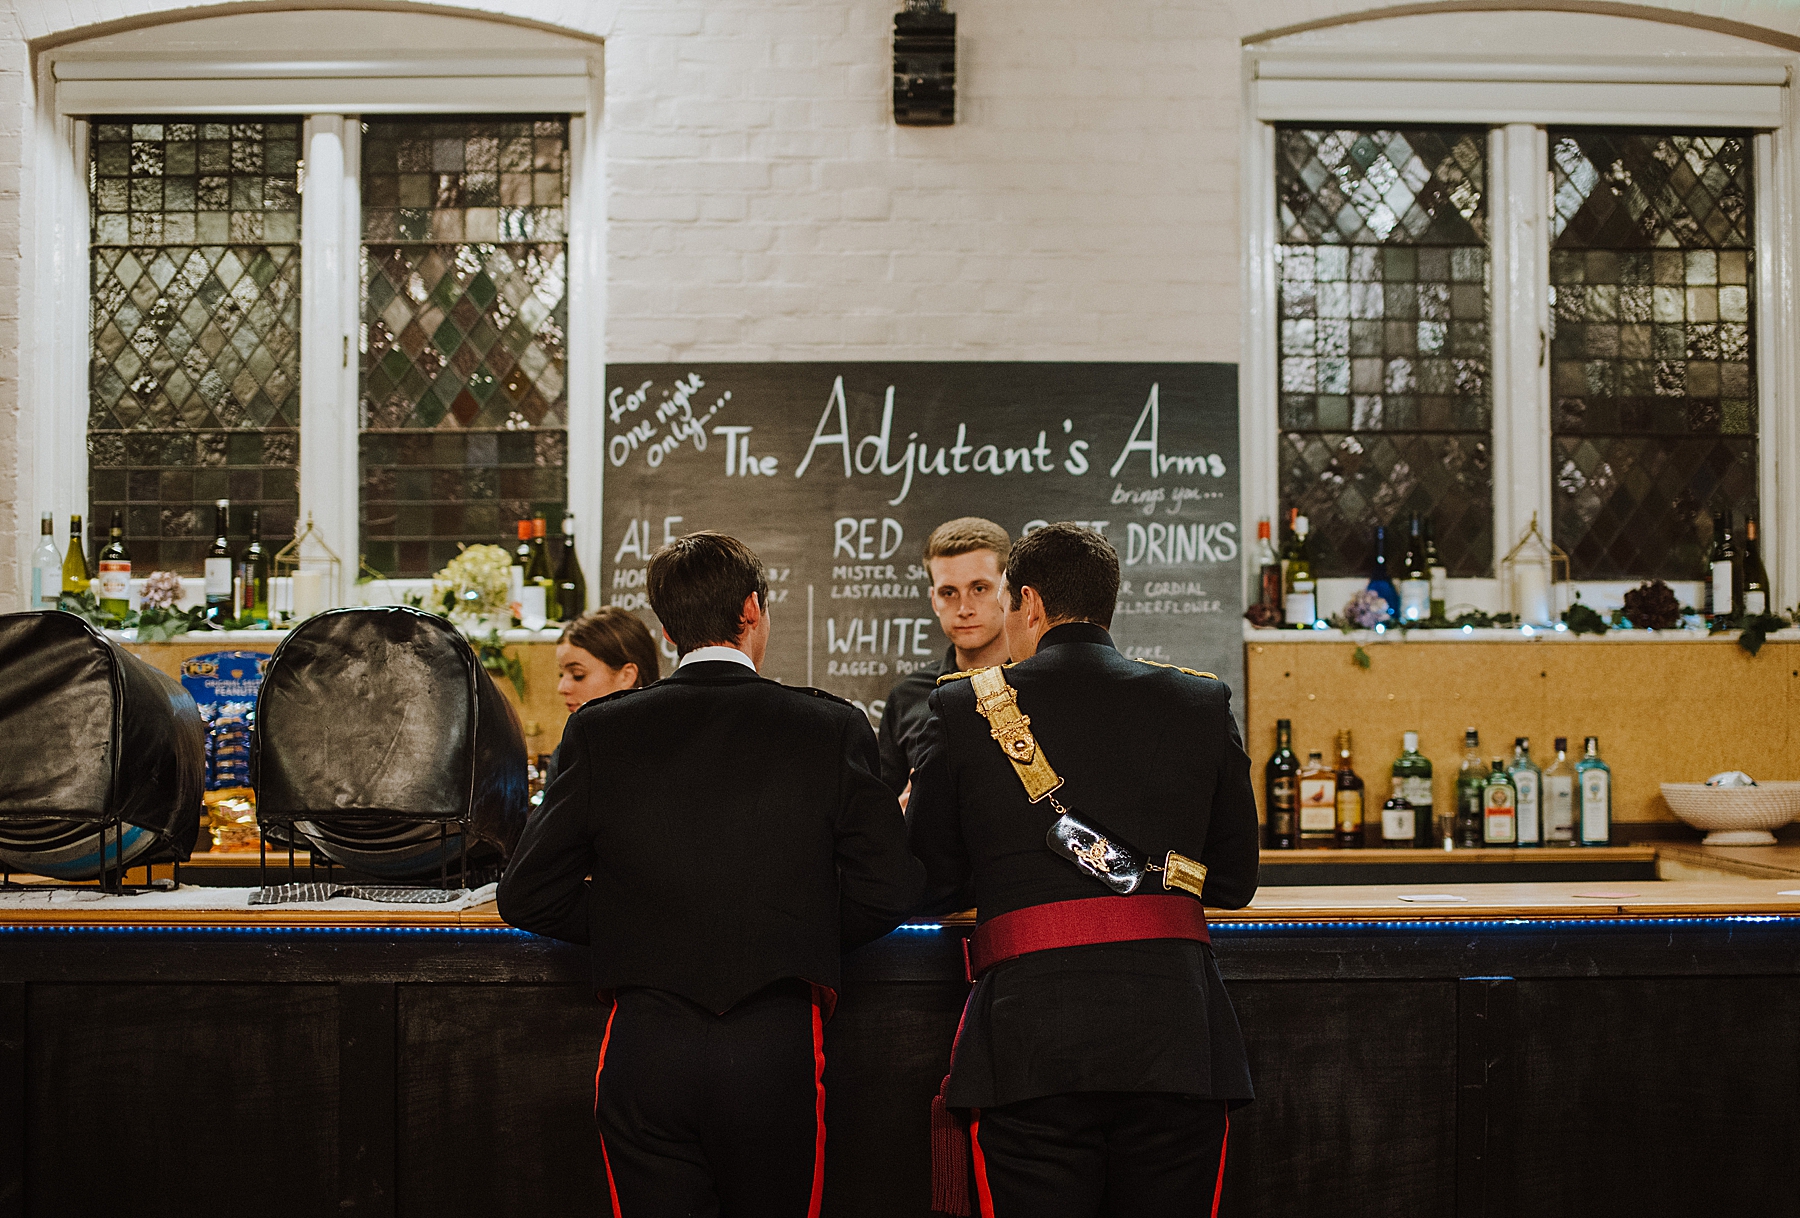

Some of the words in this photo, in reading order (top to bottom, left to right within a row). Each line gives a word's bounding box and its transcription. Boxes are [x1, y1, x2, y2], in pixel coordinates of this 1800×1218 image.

[609, 419, 658, 467] One
[655, 372, 705, 423] night
[712, 426, 778, 477] The
[795, 375, 1089, 506] Adjutant's
[1110, 382, 1226, 478] Arms
[1111, 482, 1165, 515] brings
[833, 517, 903, 560] RED
[1126, 521, 1238, 566] DRINKS
[832, 565, 898, 581] MISTER
[830, 584, 920, 599] LASTARRIA
[1144, 581, 1207, 597] CORDIAL
[1116, 600, 1223, 614] ELDERFLOWER
[827, 617, 932, 657] WHITE
[827, 660, 888, 677] RAGGED
[215, 687, 259, 697] PEANUTS
